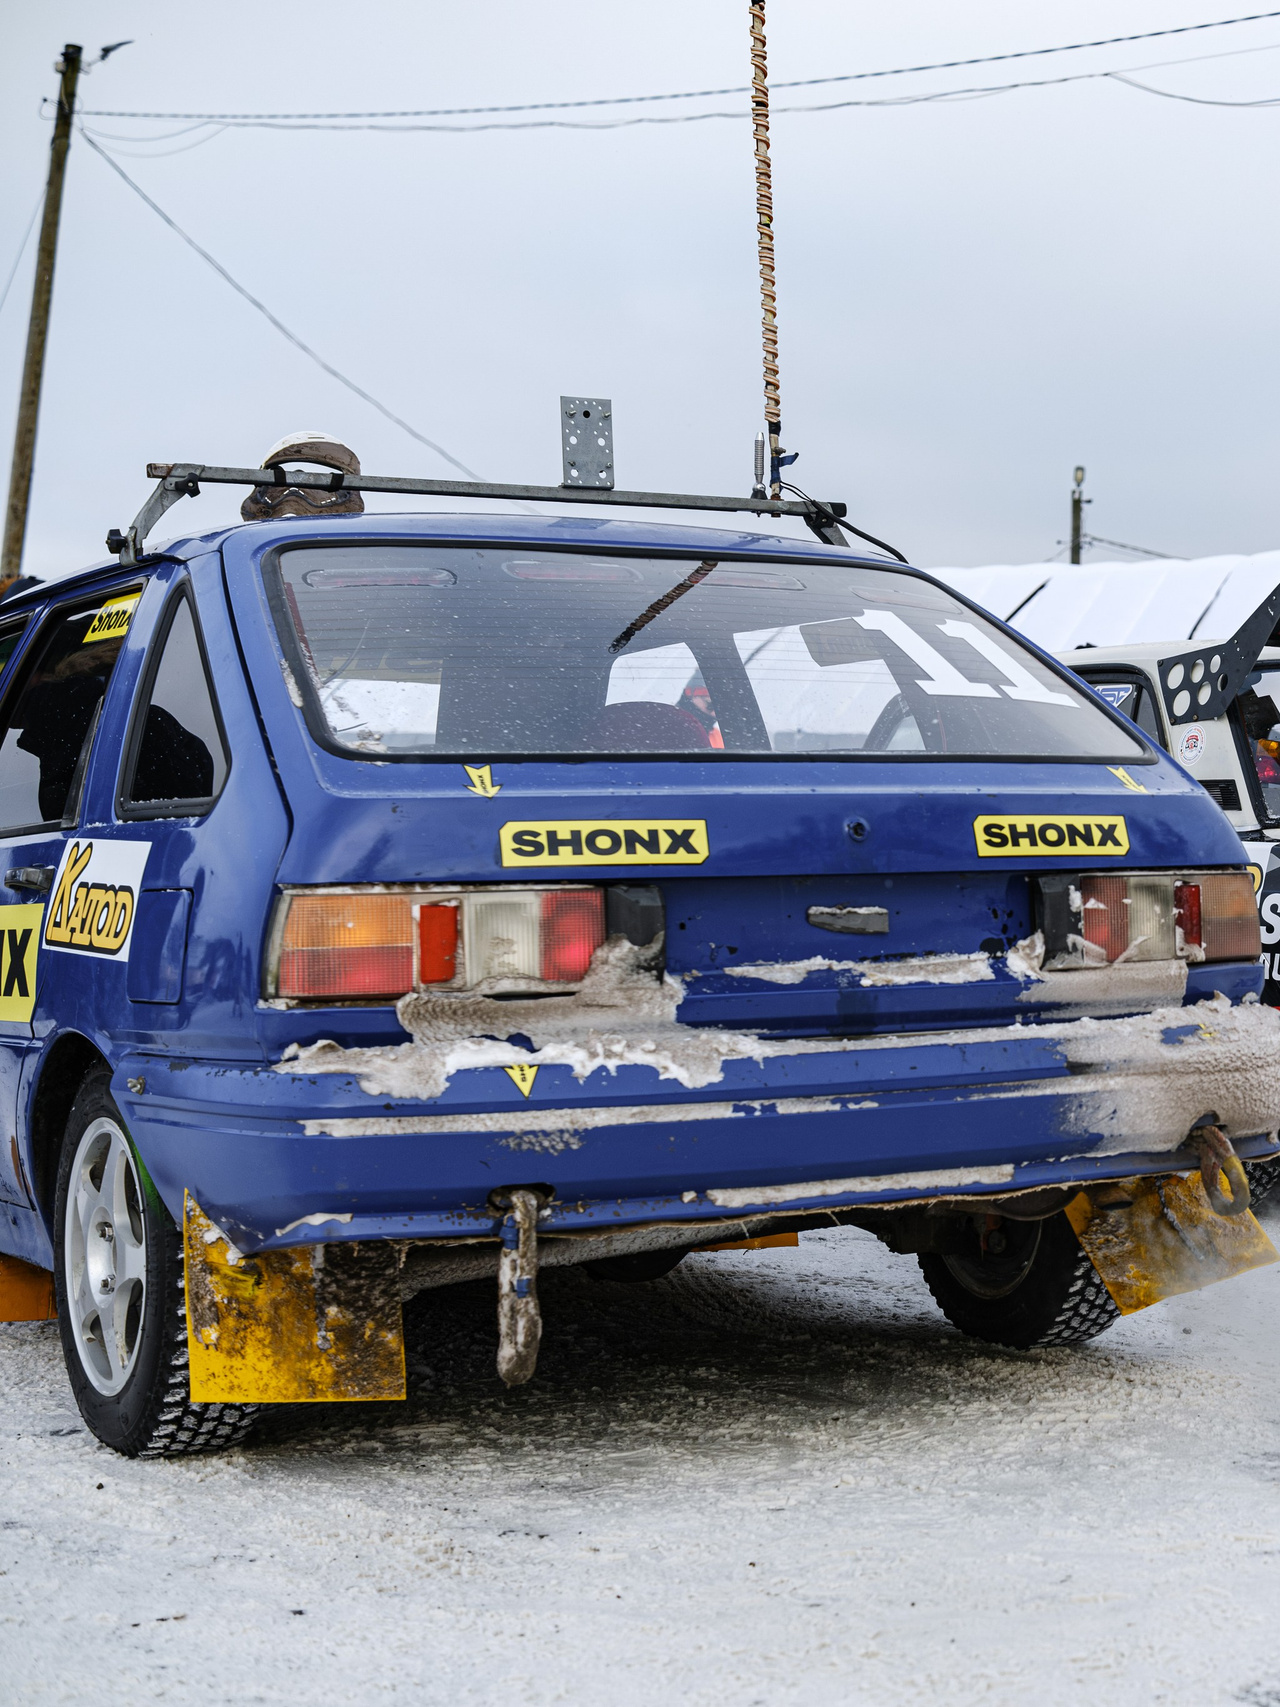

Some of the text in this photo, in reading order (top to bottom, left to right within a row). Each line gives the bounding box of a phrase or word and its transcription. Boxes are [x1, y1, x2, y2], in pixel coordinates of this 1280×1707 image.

[852, 609, 1081, 708] 11
[511, 828, 700, 857] SHONX
[983, 823, 1123, 848] SHONX
